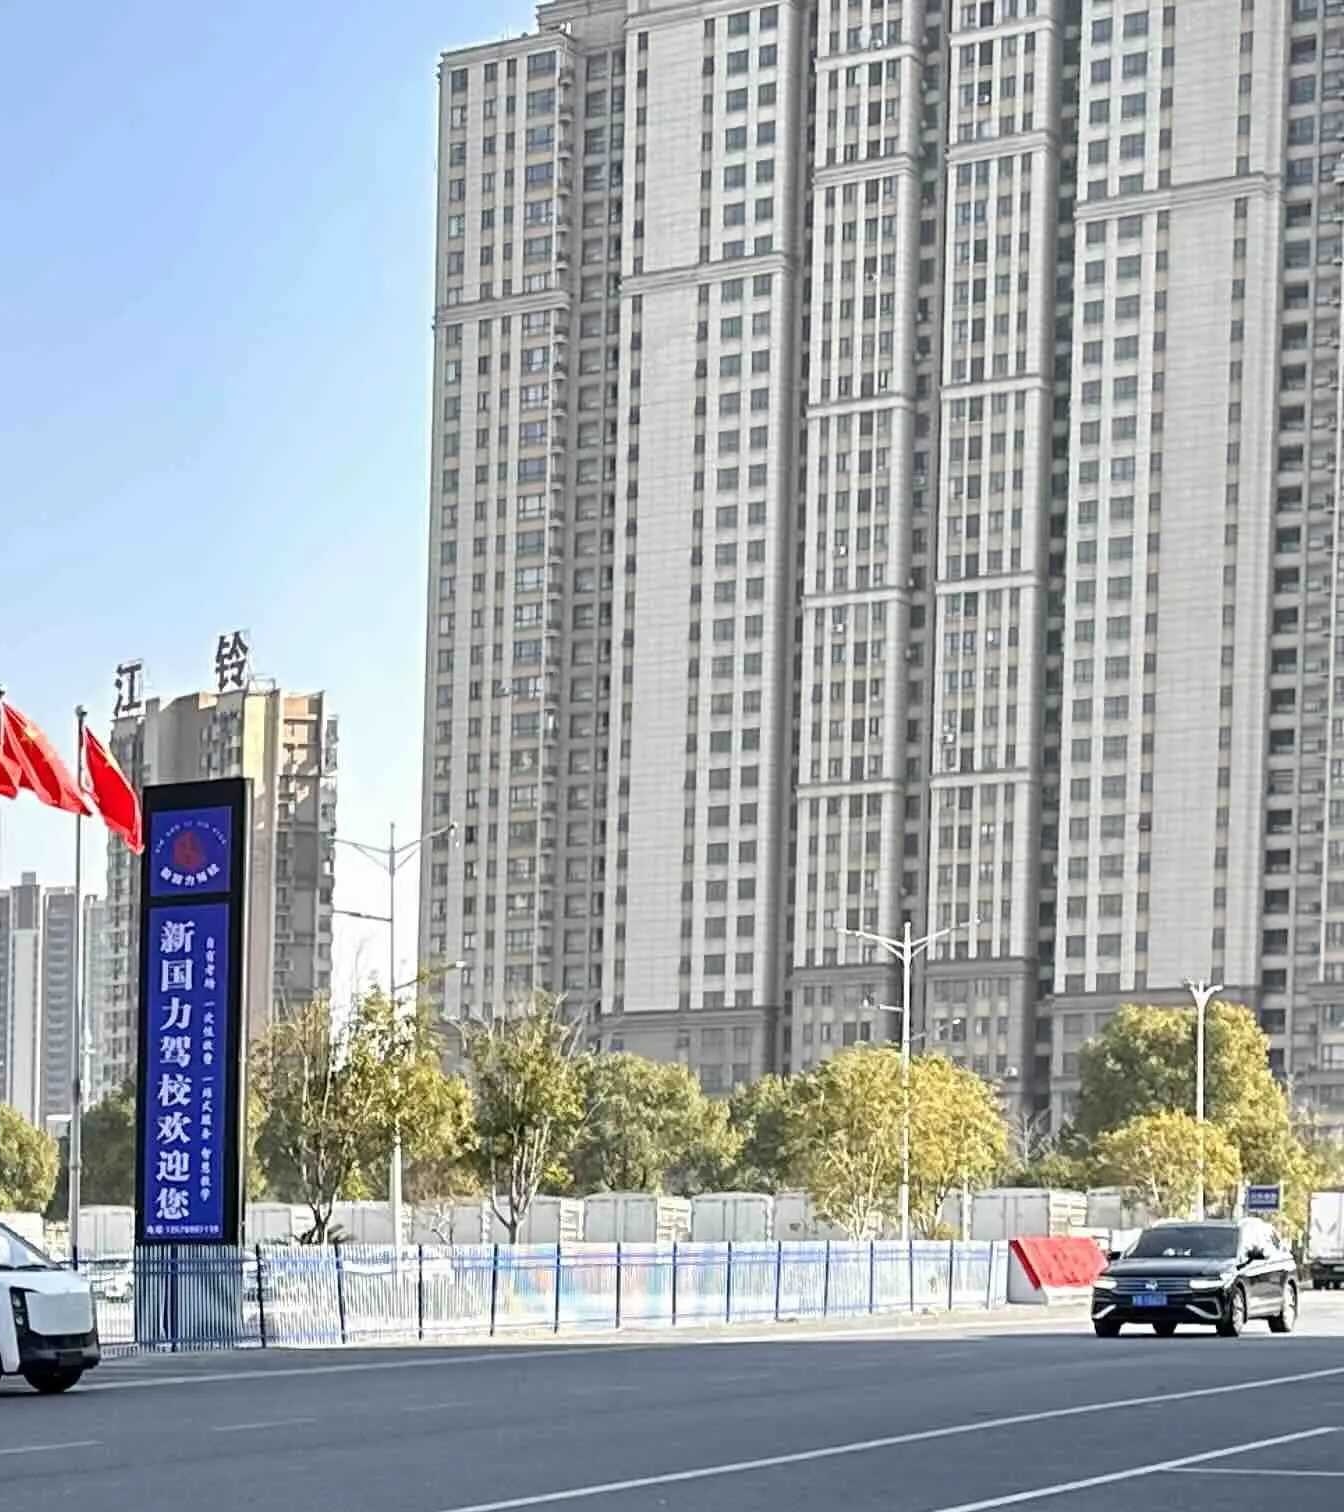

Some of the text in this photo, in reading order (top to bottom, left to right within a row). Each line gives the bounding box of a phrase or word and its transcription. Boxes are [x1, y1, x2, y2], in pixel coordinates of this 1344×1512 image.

[114, 631, 249, 717] 江铃
[156, 920, 195, 1220] 新国力驾校欢迎您
